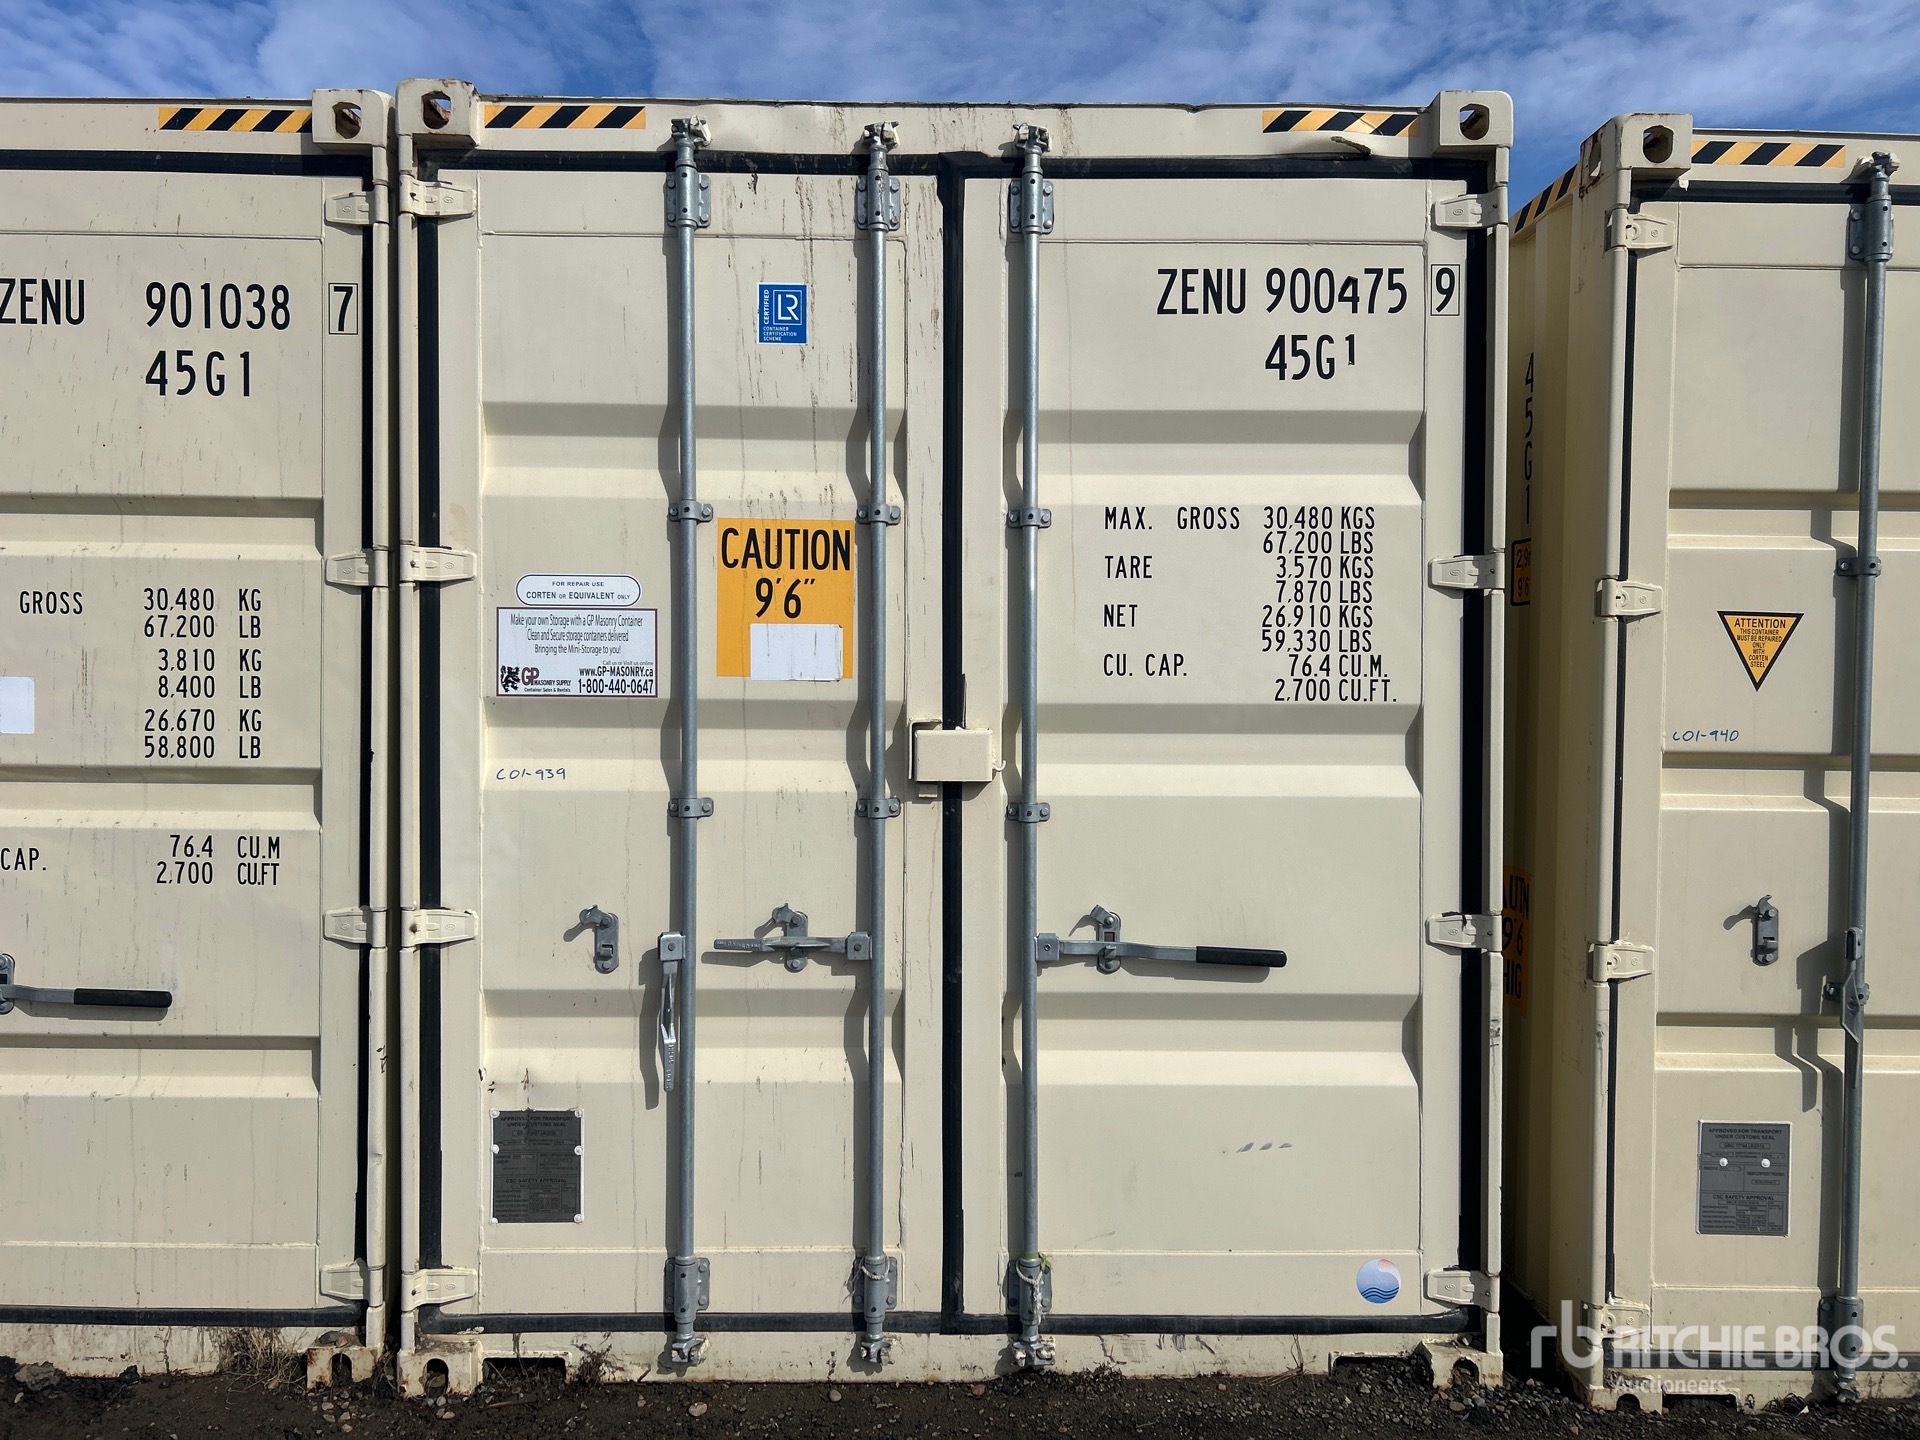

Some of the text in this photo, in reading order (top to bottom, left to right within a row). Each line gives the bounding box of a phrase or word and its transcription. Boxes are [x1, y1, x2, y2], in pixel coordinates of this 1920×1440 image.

[1156, 267, 1456, 315] ZENU 900475 9
[0, 277, 355, 332] ZENU 901038 7
[778, 294, 799, 320] LR
[1264, 333, 1355, 381] 45G1
[145, 349, 250, 397] 45G1
[1104, 505, 1375, 530] MAX. GROSS 30,480 KGS
[721, 527, 851, 571] CAUTION
[1263, 530, 1374, 555] 67,200 LBS
[1104, 555, 1374, 579] TARE 3,570 KGS
[19, 587, 262, 615] GROSS 30,480 KG
[526, 591, 557, 599] CORTEN
[568, 591, 615, 600] EQUIVALENT
[1275, 579, 1373, 604] 7,870 LBS
[143, 614, 261, 639] 67,200 LB
[510, 614, 524, 626] Make
[525, 616, 537, 628] your
[537, 616, 549, 626] own
[549, 614, 570, 629] Storage
[570, 614, 582, 626] with
[586, 614, 595, 626] GP
[595, 614, 617, 629] Masonry
[617, 614, 643, 627] Container
[1103, 604, 1373, 629] NET 26,910 KGS
[1734, 617, 1787, 629] ATTENTION
[527, 628, 629, 645] Clean and Secure storage containers delivered
[1261, 628, 1372, 653] 59,330 LBS
[1736, 634, 1750, 642] MUST
[1758, 635, 1783, 643] REPAIRED
[1751, 628, 1780, 636] CONTAINER
[534, 643, 558, 655] Bringing
[558, 644, 568, 654] the
[602, 646, 609, 654] to
[1752, 641, 1766, 649] ONLY
[157, 648, 262, 672] 3,810 KG
[1103, 653, 1388, 678] CU. CAP. 76.4 CU.M.
[1748, 654, 1769, 662] CORTEN
[521, 667, 540, 686] GP
[555, 679, 572, 687] SUPPLY
[578, 666, 654, 677] www.GP-MASONRY.ca
[158, 674, 262, 699] 8,400 LB
[577, 678, 654, 694] 1-800-440-0647
[1274, 678, 1397, 703] 2,700 CU.FT.
[144, 708, 262, 732] 26,670 KG
[144, 735, 261, 759] 58,800 LB
[169, 834, 280, 860] 76.4 CU.M
[0, 847, 280, 886] CAP. 2,700 CU.FT
